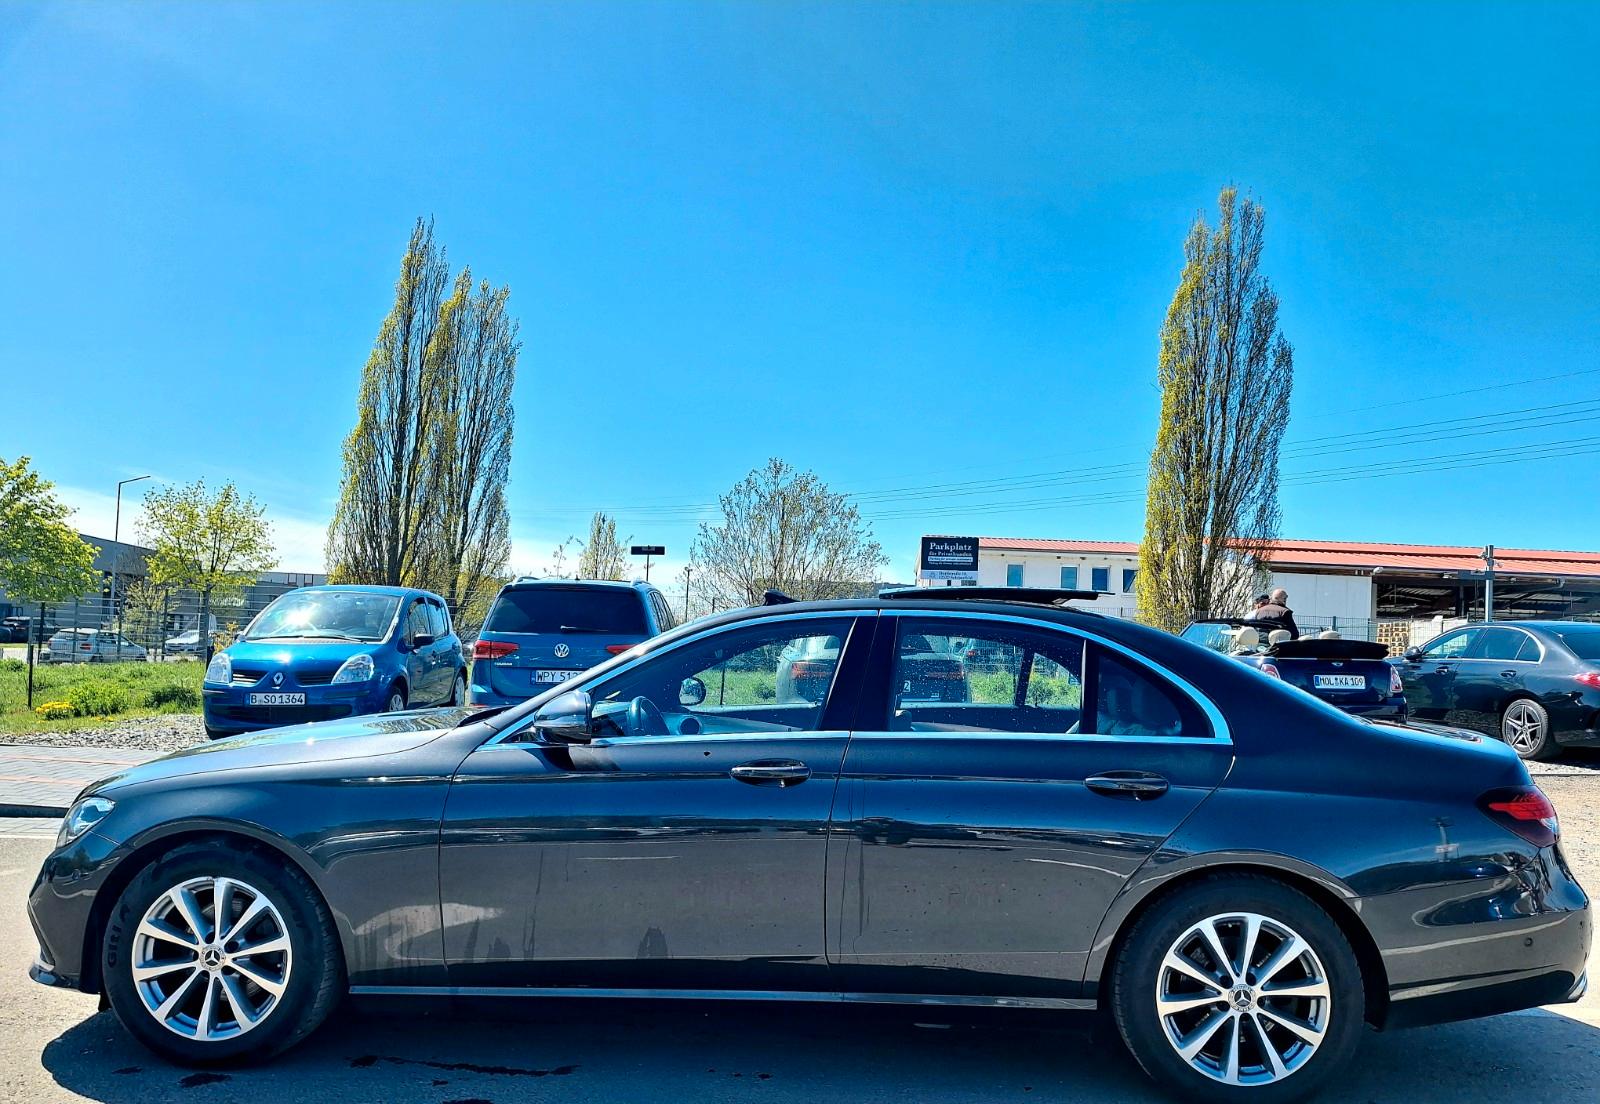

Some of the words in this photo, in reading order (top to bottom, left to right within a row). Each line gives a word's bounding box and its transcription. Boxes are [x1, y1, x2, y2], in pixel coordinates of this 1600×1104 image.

[930, 542, 972, 552] Parkplatz
[537, 672, 556, 681] WPY
[251, 695, 257, 704] B
